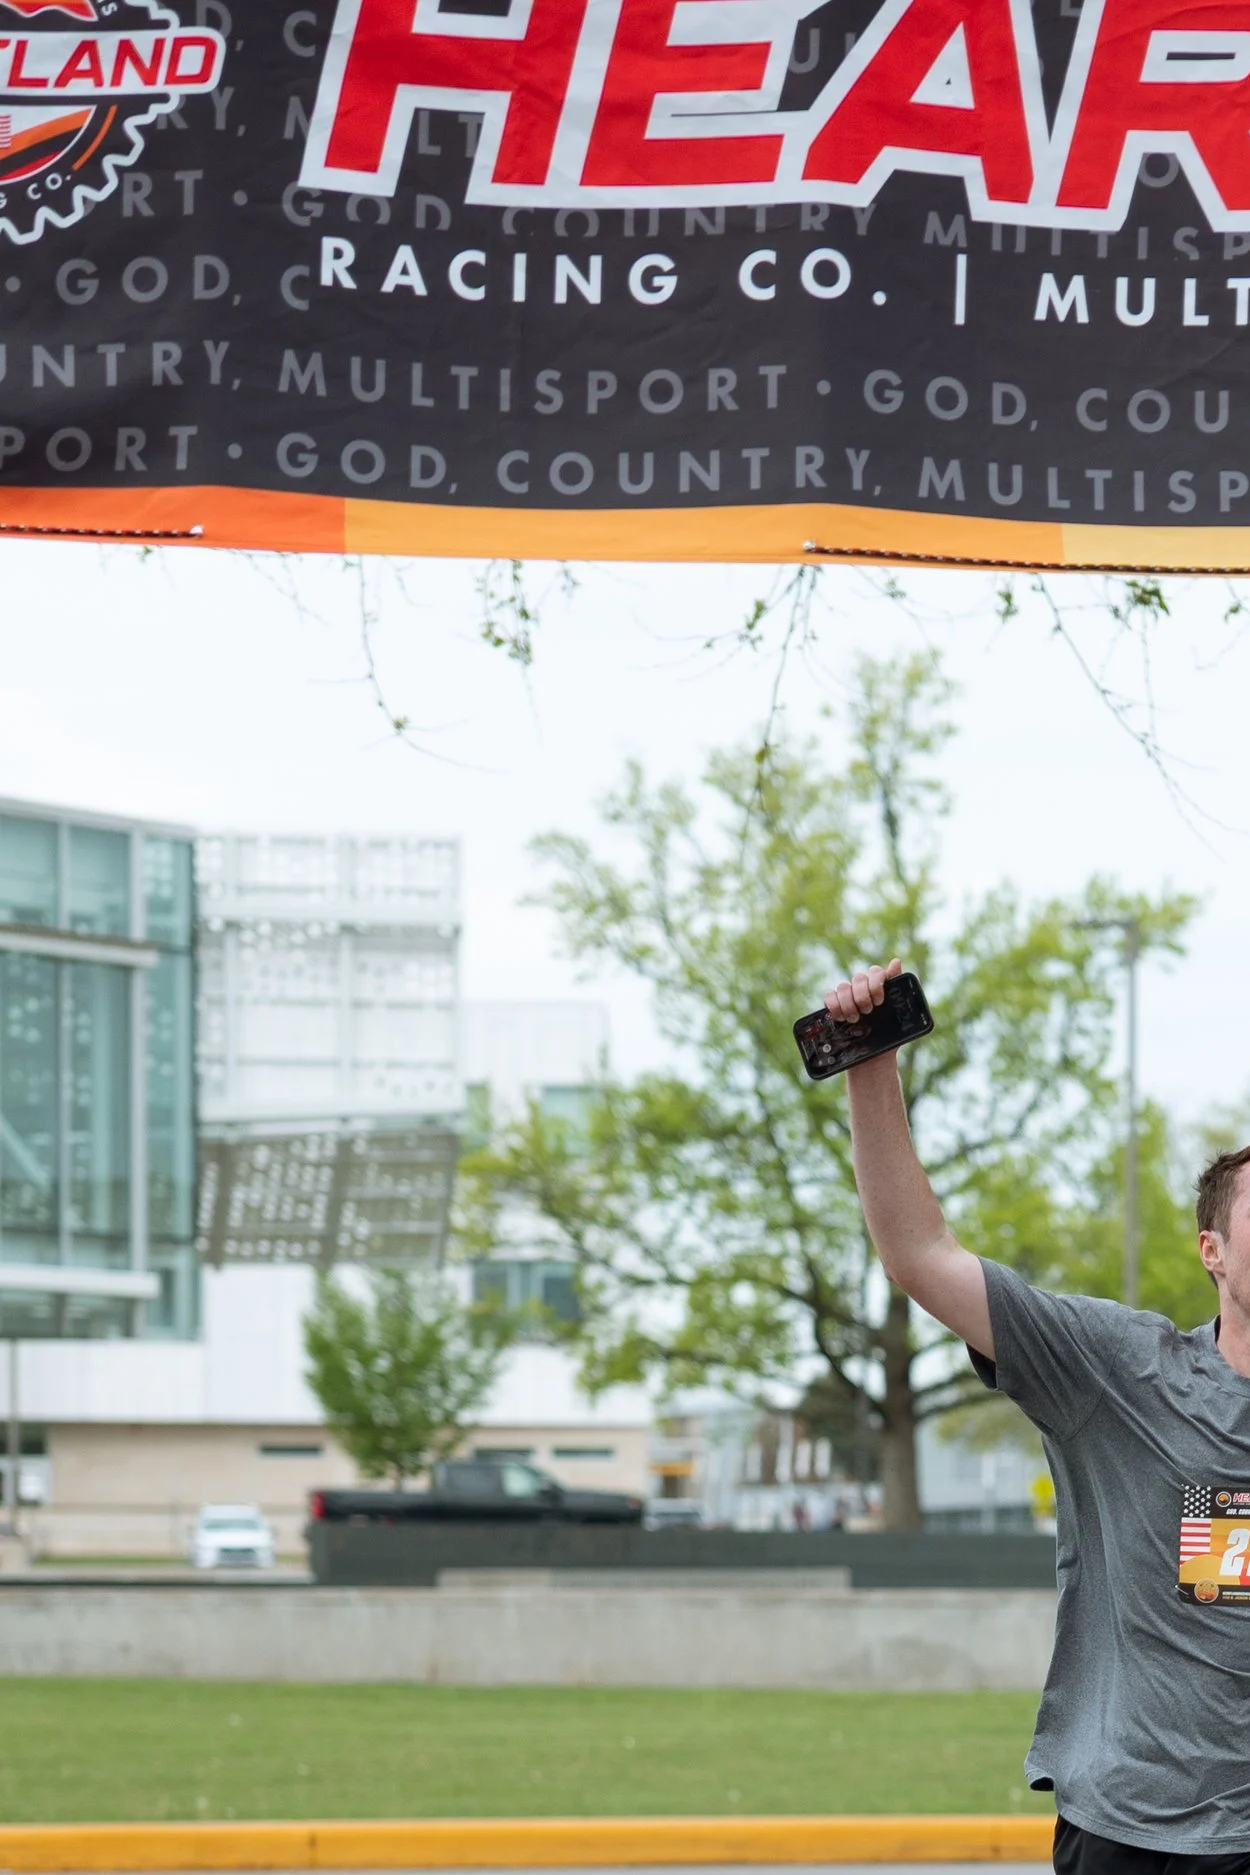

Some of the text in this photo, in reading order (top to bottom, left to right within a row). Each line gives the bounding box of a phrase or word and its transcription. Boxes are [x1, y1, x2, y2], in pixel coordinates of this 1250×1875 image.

[0, 36, 218, 88] LAND
[56, 254, 242, 306] GOD,
[319, 235, 679, 305] RACING
[738, 247, 888, 306] CO.
[0, 340, 242, 390] NTRY,
[278, 349, 787, 415] MULTISPORT
[863, 370, 1038, 432] GOD,
[277, 433, 459, 496] GOD,
[497, 446, 882, 497] COUNTRY,
